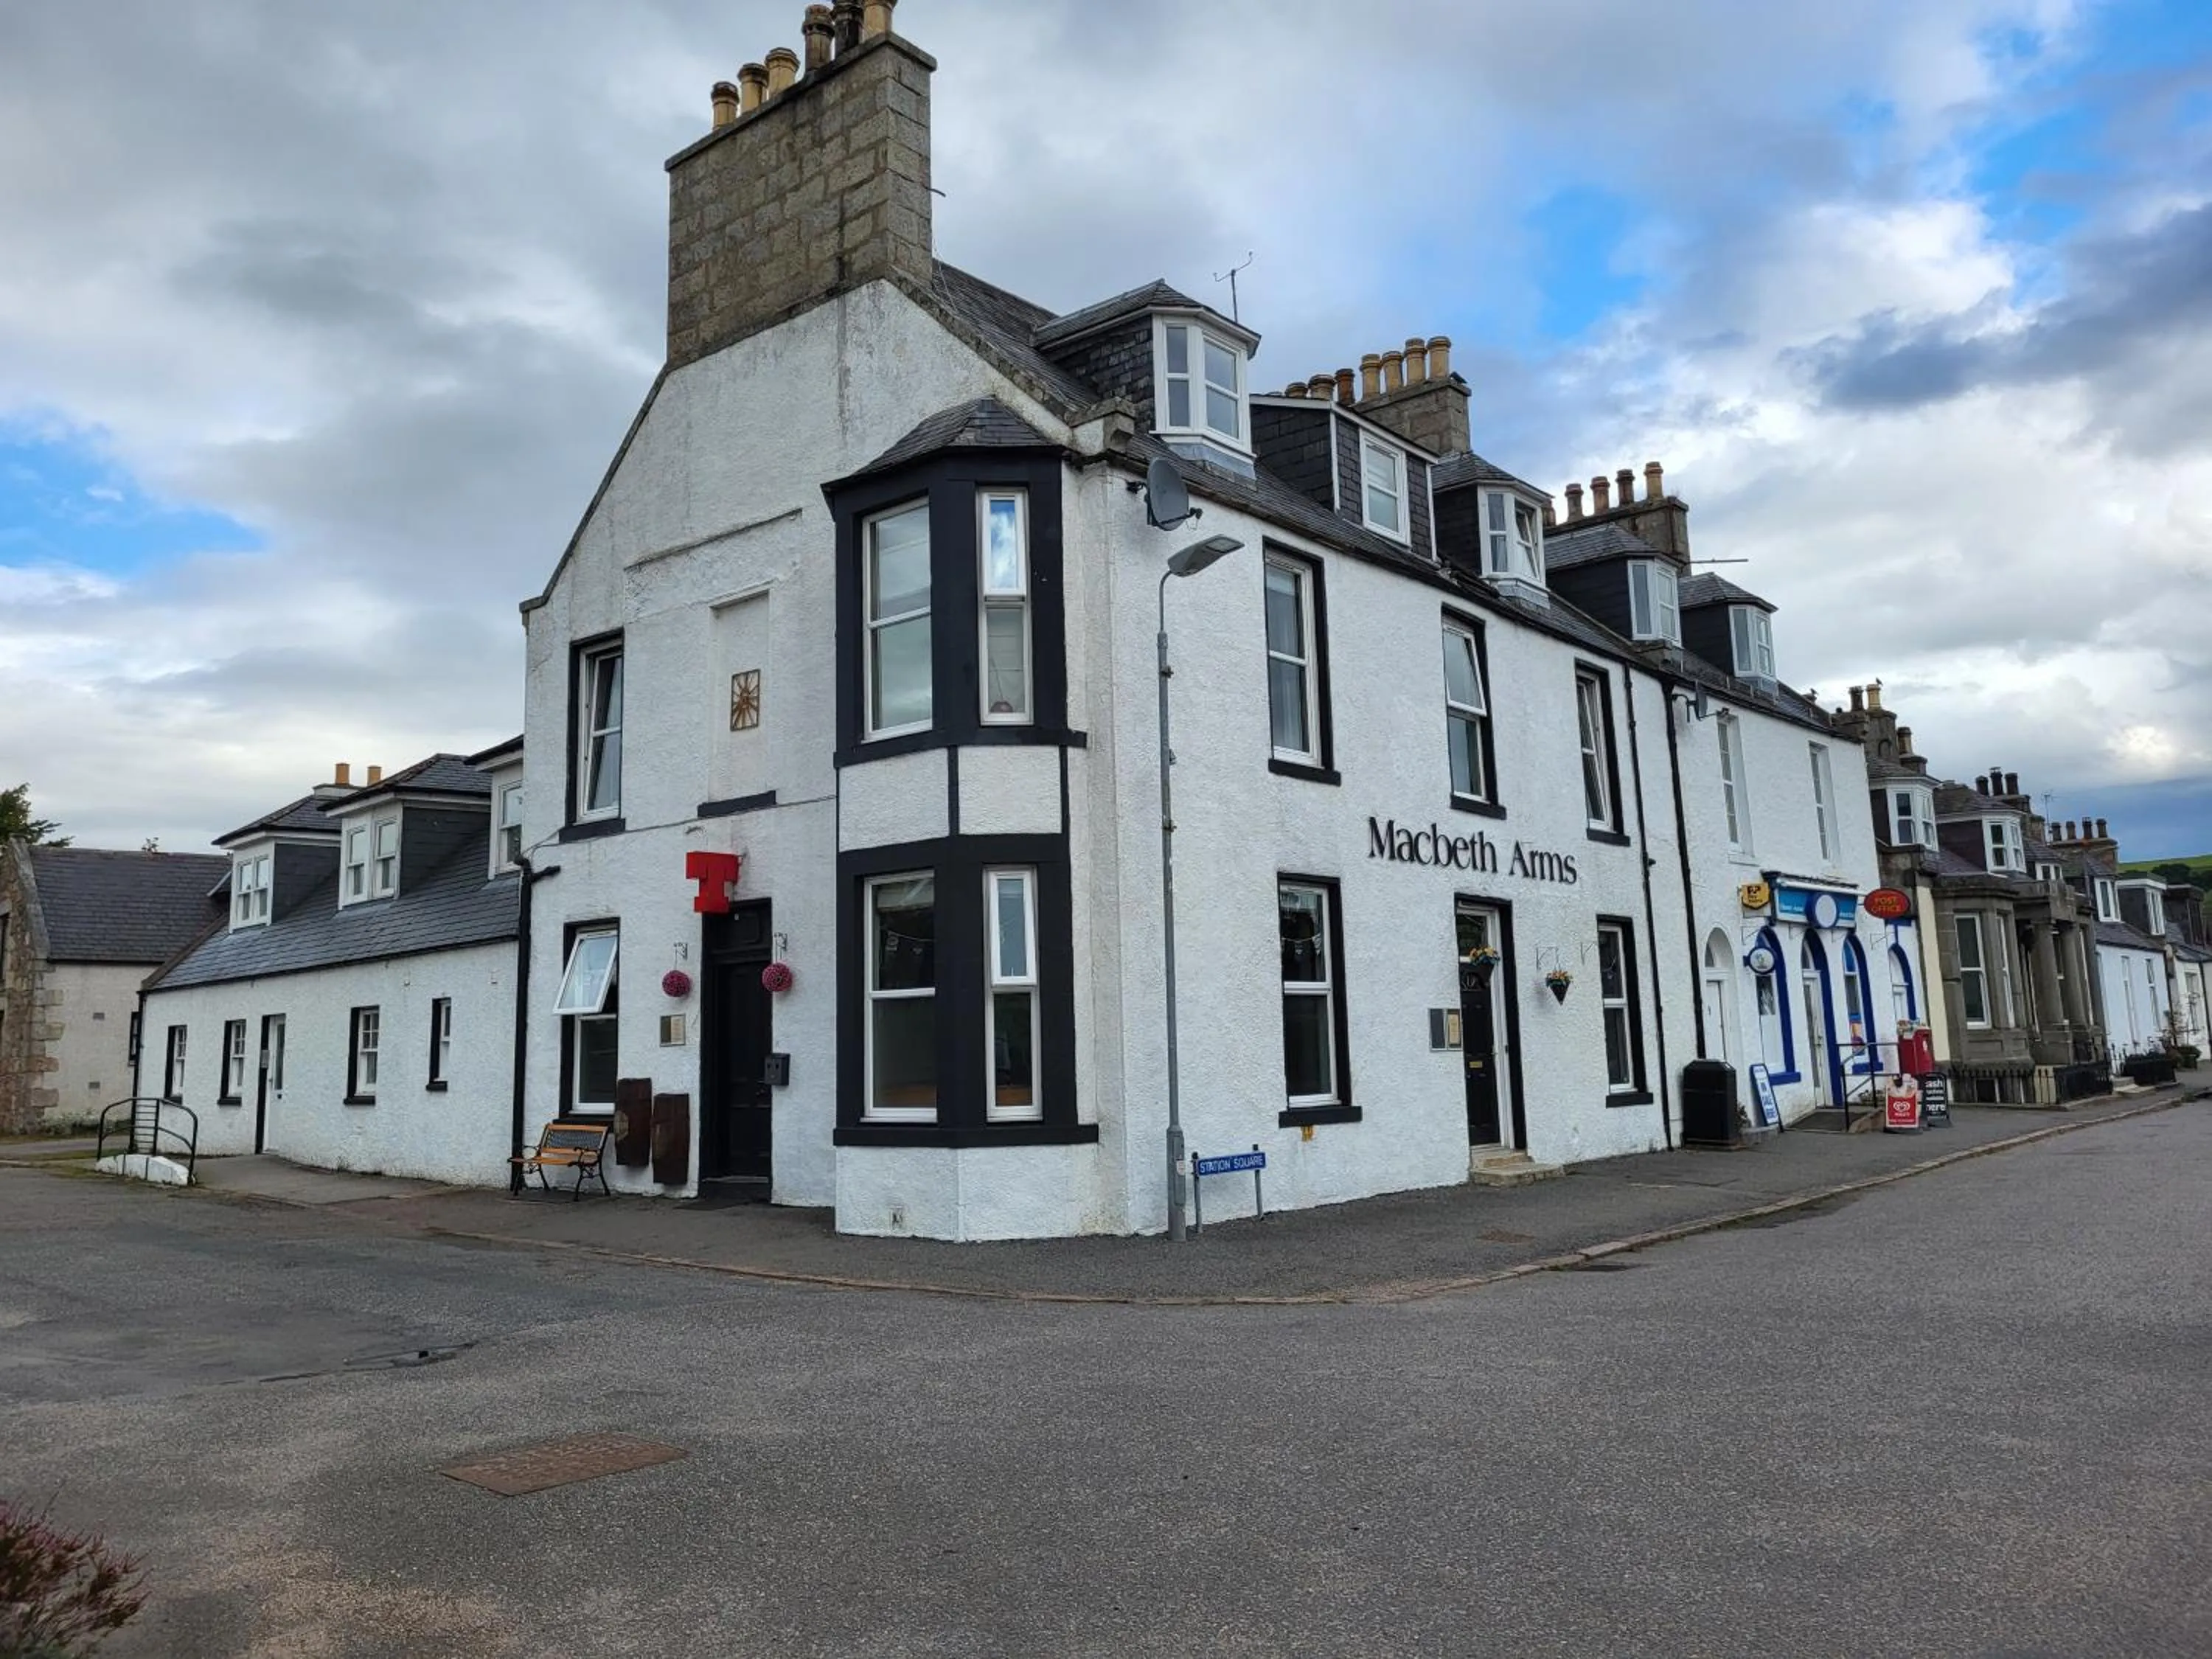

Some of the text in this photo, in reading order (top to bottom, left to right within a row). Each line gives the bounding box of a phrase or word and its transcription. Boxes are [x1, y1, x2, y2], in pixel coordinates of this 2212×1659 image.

[1368, 815, 1578, 885] Macbeth Arms
[686, 850, 740, 914] T
[1874, 895, 1899, 905] POST
[1200, 1160, 1231, 1173] STATION
[1234, 1156, 1263, 1169] SQUARE
